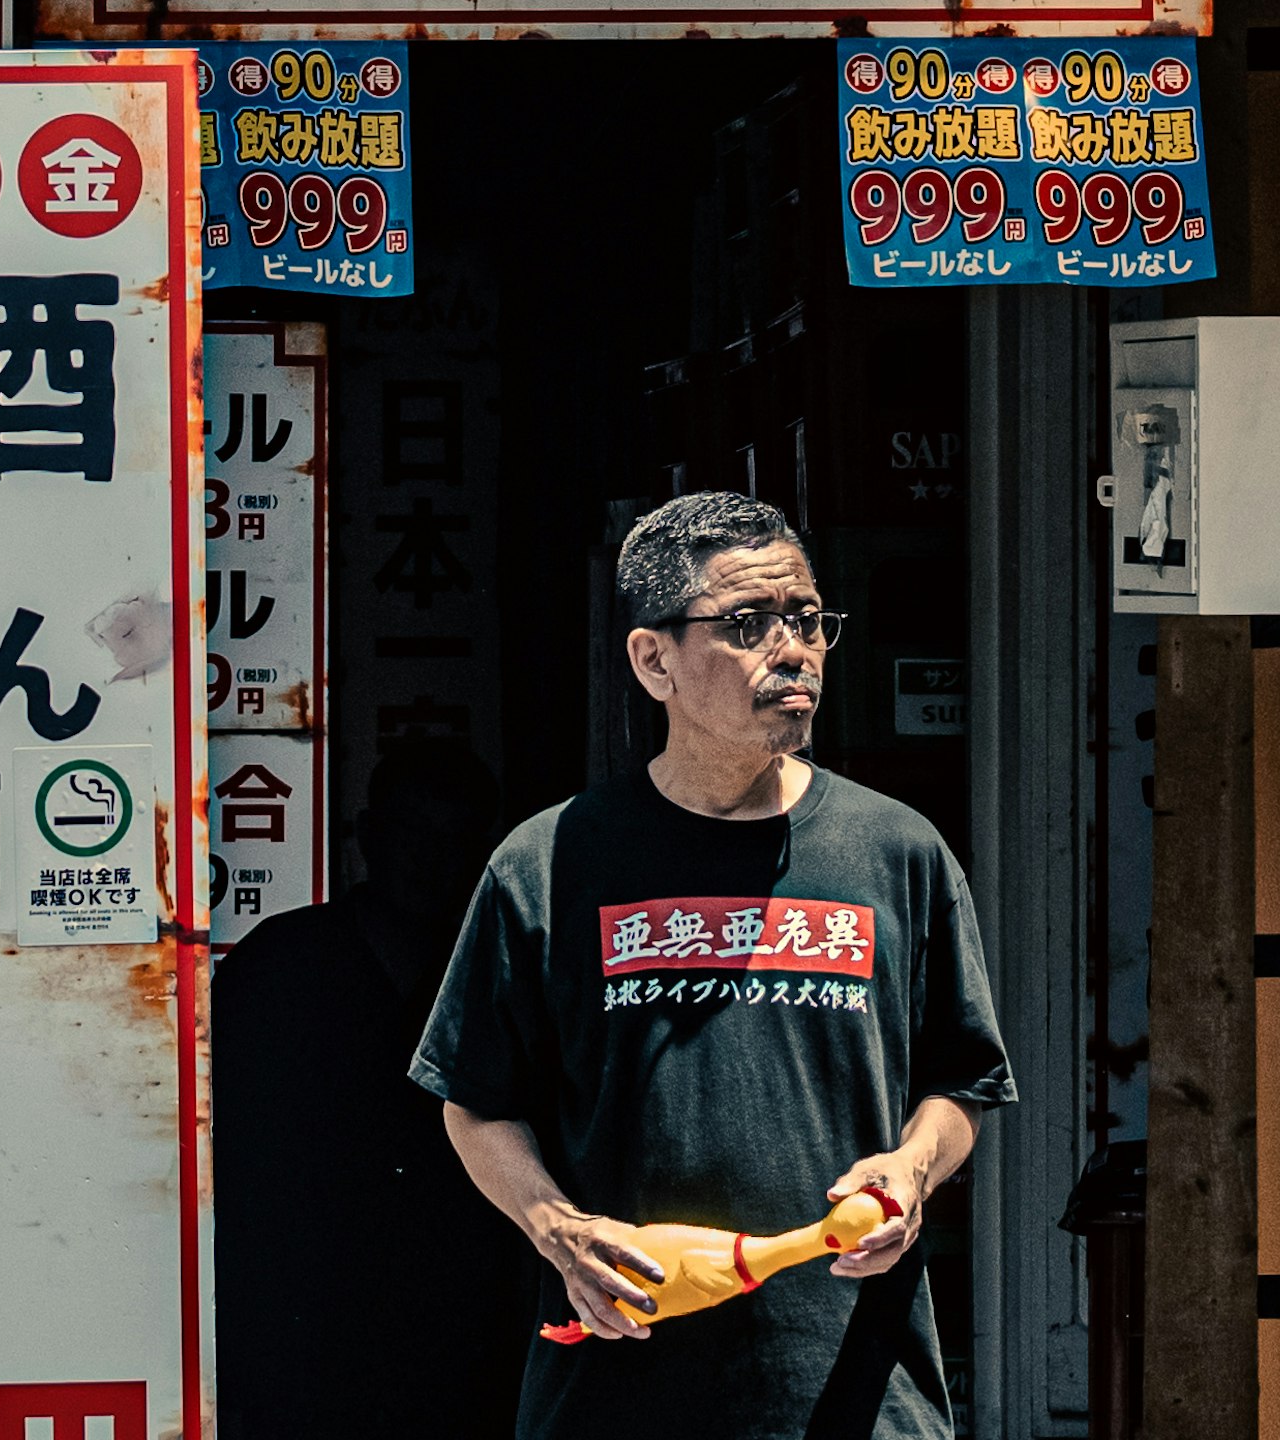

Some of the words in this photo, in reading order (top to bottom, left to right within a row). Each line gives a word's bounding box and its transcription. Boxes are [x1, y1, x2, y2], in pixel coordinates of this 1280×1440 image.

[235, 108, 404, 170] 飲み放題
[848, 105, 1021, 163] 飲み放題
[1027, 108, 1197, 165] 飲み放題
[263, 255, 393, 288] ビールなし
[873, 250, 1012, 278] ビールなし
[1057, 250, 1193, 278] ビールなし
[39, 867, 131, 887] 当店は全席
[31, 887, 141, 907] 喫煙OKです
[604, 906, 870, 967] 亜無亜危異
[604, 977, 869, 1014] 東北ライブハウス大作戦
